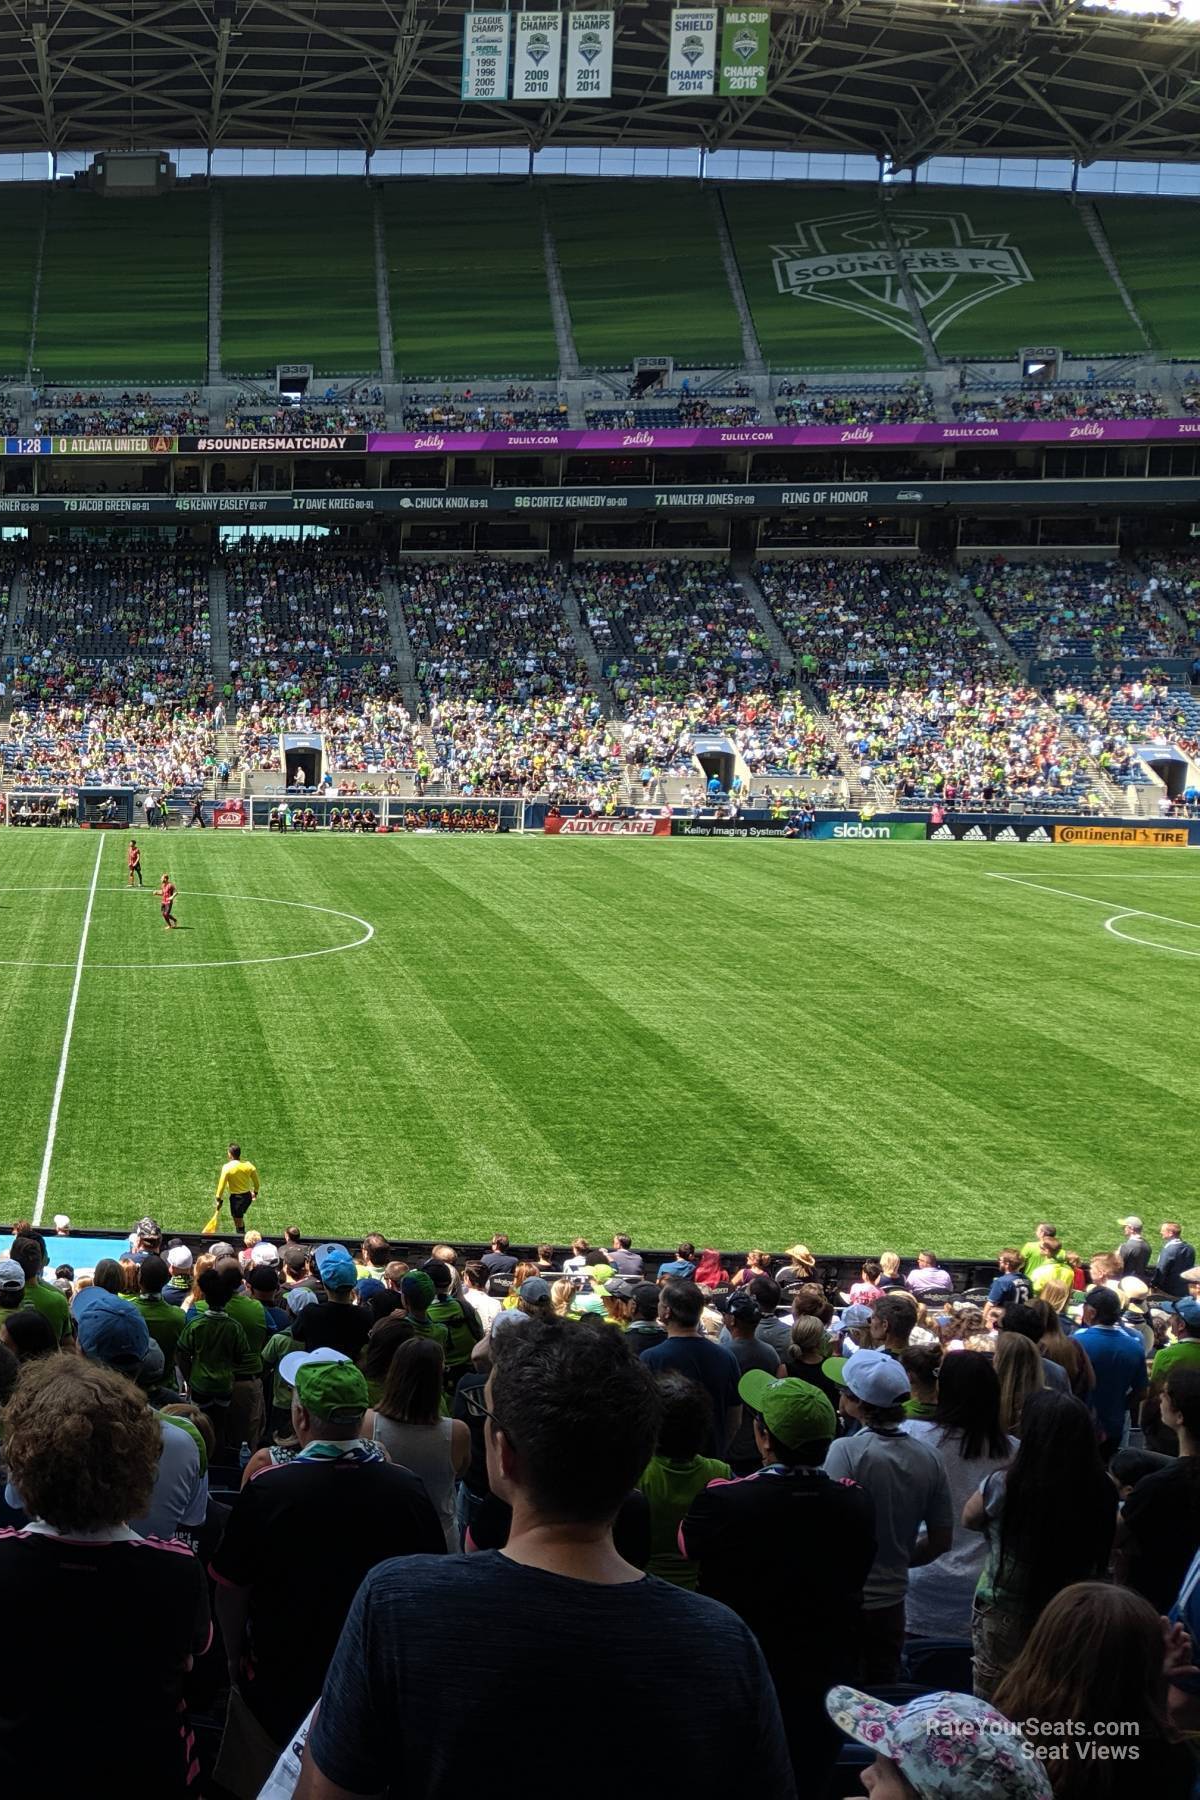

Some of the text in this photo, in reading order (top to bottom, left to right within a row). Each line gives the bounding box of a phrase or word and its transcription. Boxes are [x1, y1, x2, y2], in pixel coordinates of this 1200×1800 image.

[726, 13, 768, 23] MLS CUP
[521, 21, 558, 31] CHAMPS
[573, 20, 610, 30] CHAMPS
[675, 21, 713, 31] SHIELD
[525, 70, 549, 80] 2009
[577, 70, 599, 79] 2011
[671, 70, 713, 79] CHAMPS
[724, 66, 764, 76] CHAMPS
[525, 82, 548, 92] 2010
[577, 81, 600, 91] 2014
[678, 81, 702, 90] 2014
[730, 78, 757, 89] 2016
[970, 258, 1010, 272] FC
[721, 432, 773, 440] ZULILY.COM
[944, 429, 998, 437] ZULILY.COM
[71, 439, 148, 452] ATLANTA UNITED
[198, 438, 346, 450] #SOUNDERSMATCHDAY
[508, 436, 558, 445] ZULILY.COM
[17, 440, 41, 453] 1:28
[60, 440, 66, 453] 0
[415, 497, 468, 508] CHUCK KNOX
[515, 496, 606, 508] 96 CORTEZ KENNEDY
[656, 494, 734, 505] 71 WALTER JONES
[782, 491, 868, 504] RING OF HONOR
[64, 501, 131, 511] 79 JACOB GREEN
[176, 500, 249, 510] 45 KENNY EASLEY
[293, 500, 304, 508] 17
[306, 500, 326, 509] DAVE
[328, 500, 354, 509] KRIEG
[560, 820, 655, 833] ADVOCARE
[685, 826, 711, 835] Kelley
[713, 827, 747, 836] Imaging
[833, 823, 890, 838] slalom
[1060, 827, 1183, 842] Continental TIRE
